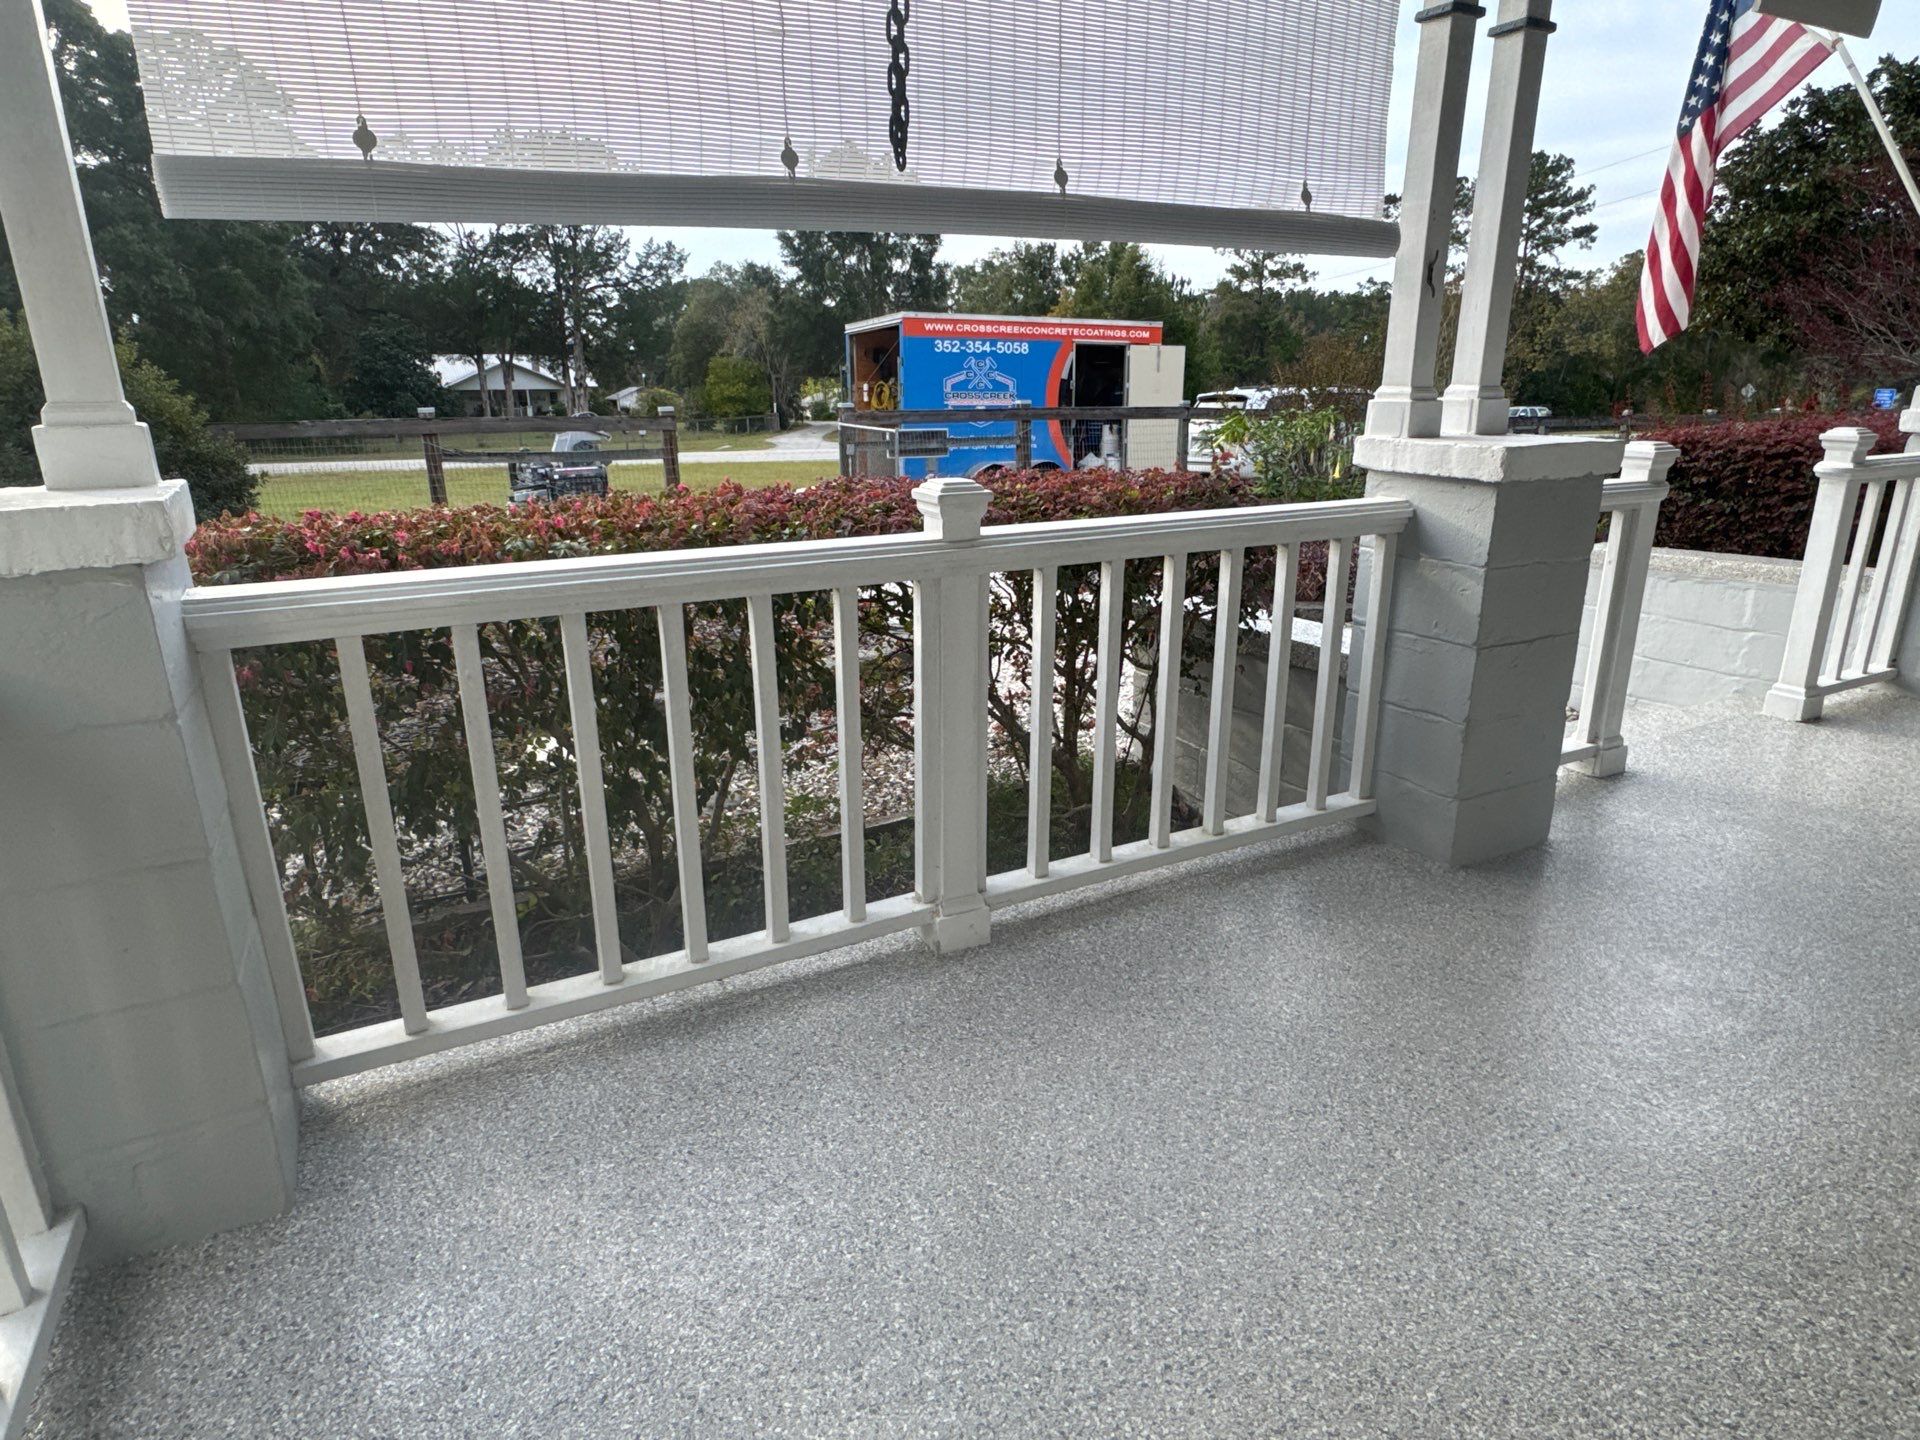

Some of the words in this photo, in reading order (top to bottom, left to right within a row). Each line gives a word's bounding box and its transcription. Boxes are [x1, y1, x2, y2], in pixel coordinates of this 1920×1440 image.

[924, 322, 1150, 338] WWW.CROSSCREEKCONCRETECOATINGS.COM
[934, 340, 1030, 355] 352-354-5058
[944, 392, 980, 400] CROSS
[983, 392, 1016, 400] CREEK
